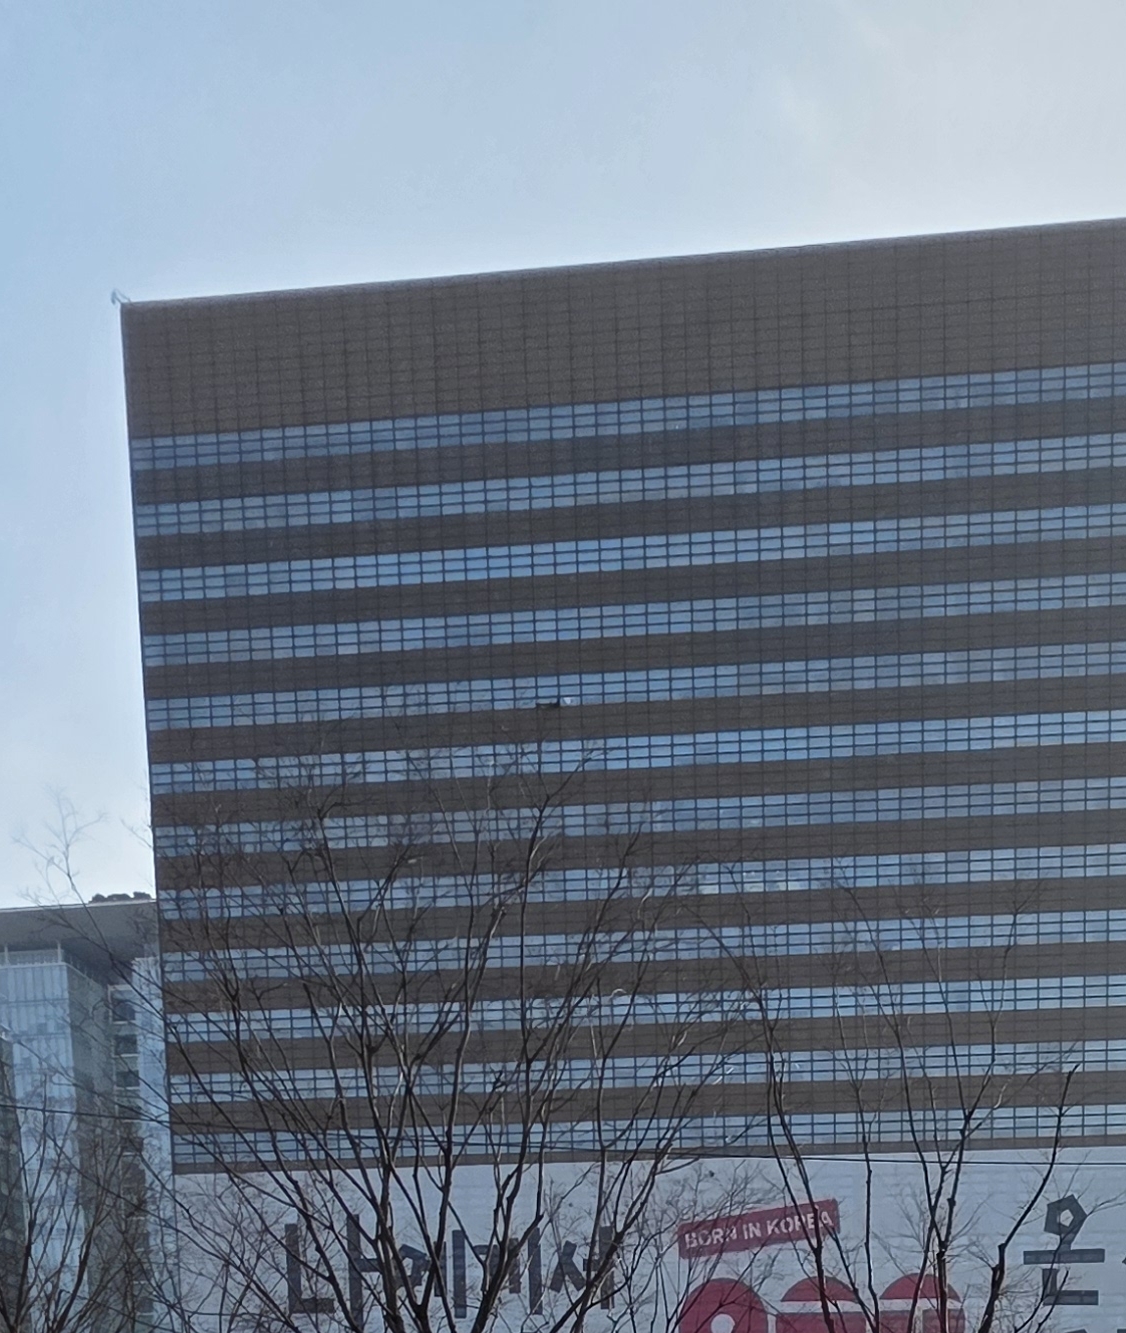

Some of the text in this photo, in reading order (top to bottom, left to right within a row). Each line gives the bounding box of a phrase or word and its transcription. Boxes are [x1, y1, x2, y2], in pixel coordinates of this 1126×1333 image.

[684, 1210, 835, 1249] BORN IN KOREA
[1023, 1193, 1106, 1306] 온
